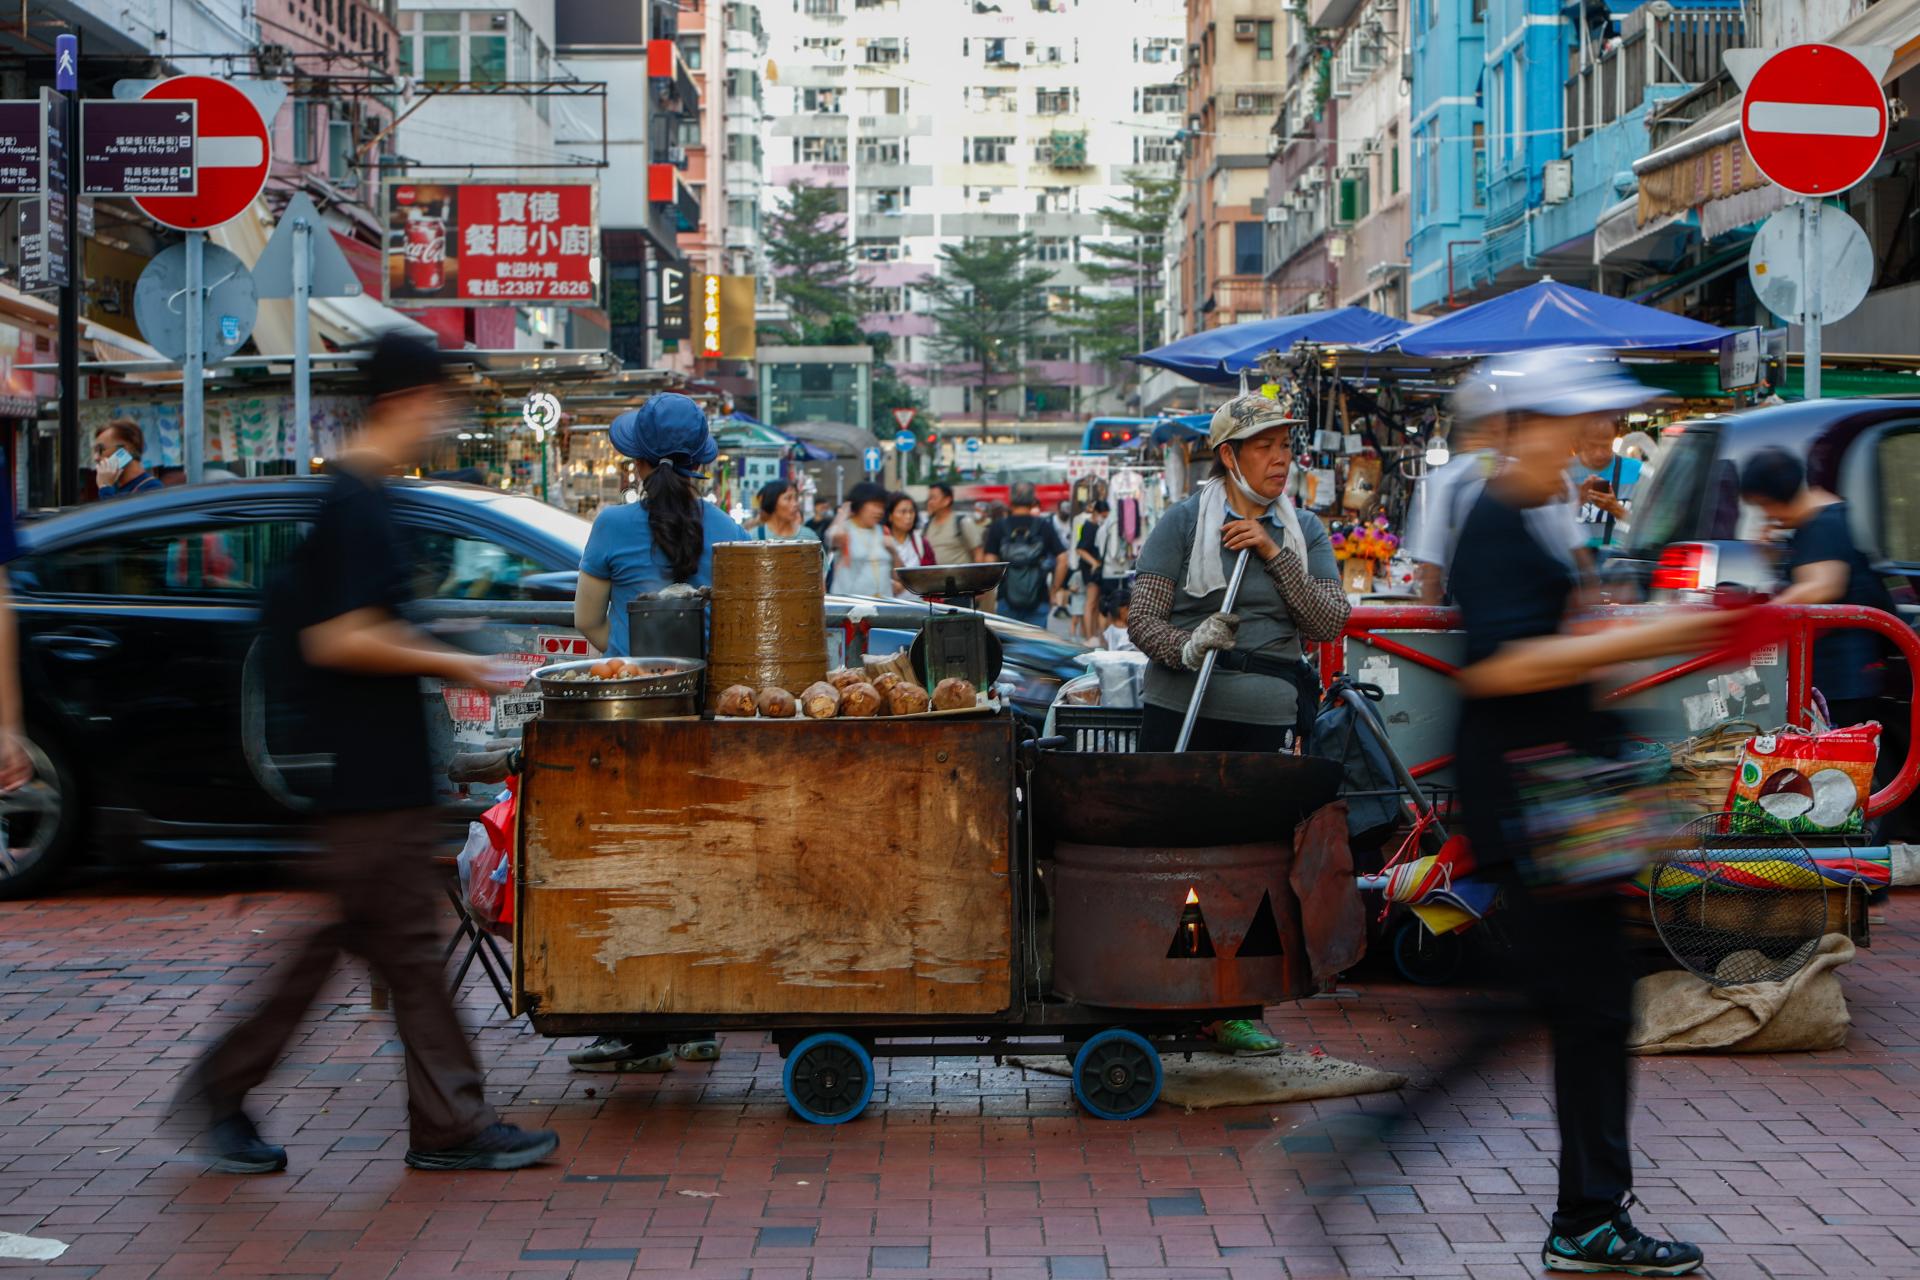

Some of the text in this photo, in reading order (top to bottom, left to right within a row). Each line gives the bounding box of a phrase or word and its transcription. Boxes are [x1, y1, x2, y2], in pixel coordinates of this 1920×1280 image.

[7, 146, 38, 154] Hospital
[120, 146, 137, 154] Wing
[148, 146, 165, 154] (Toy
[166, 146, 179, 154] St)
[17, 176, 37, 184] Tomb
[124, 185, 161, 193] Sitting-out
[496, 192, 560, 222] 寶德
[465, 224, 590, 256] 餐廳小廚
[495, 262, 558, 278] 歡迎外賣
[467, 280, 589, 296] 電話:2387 2626
